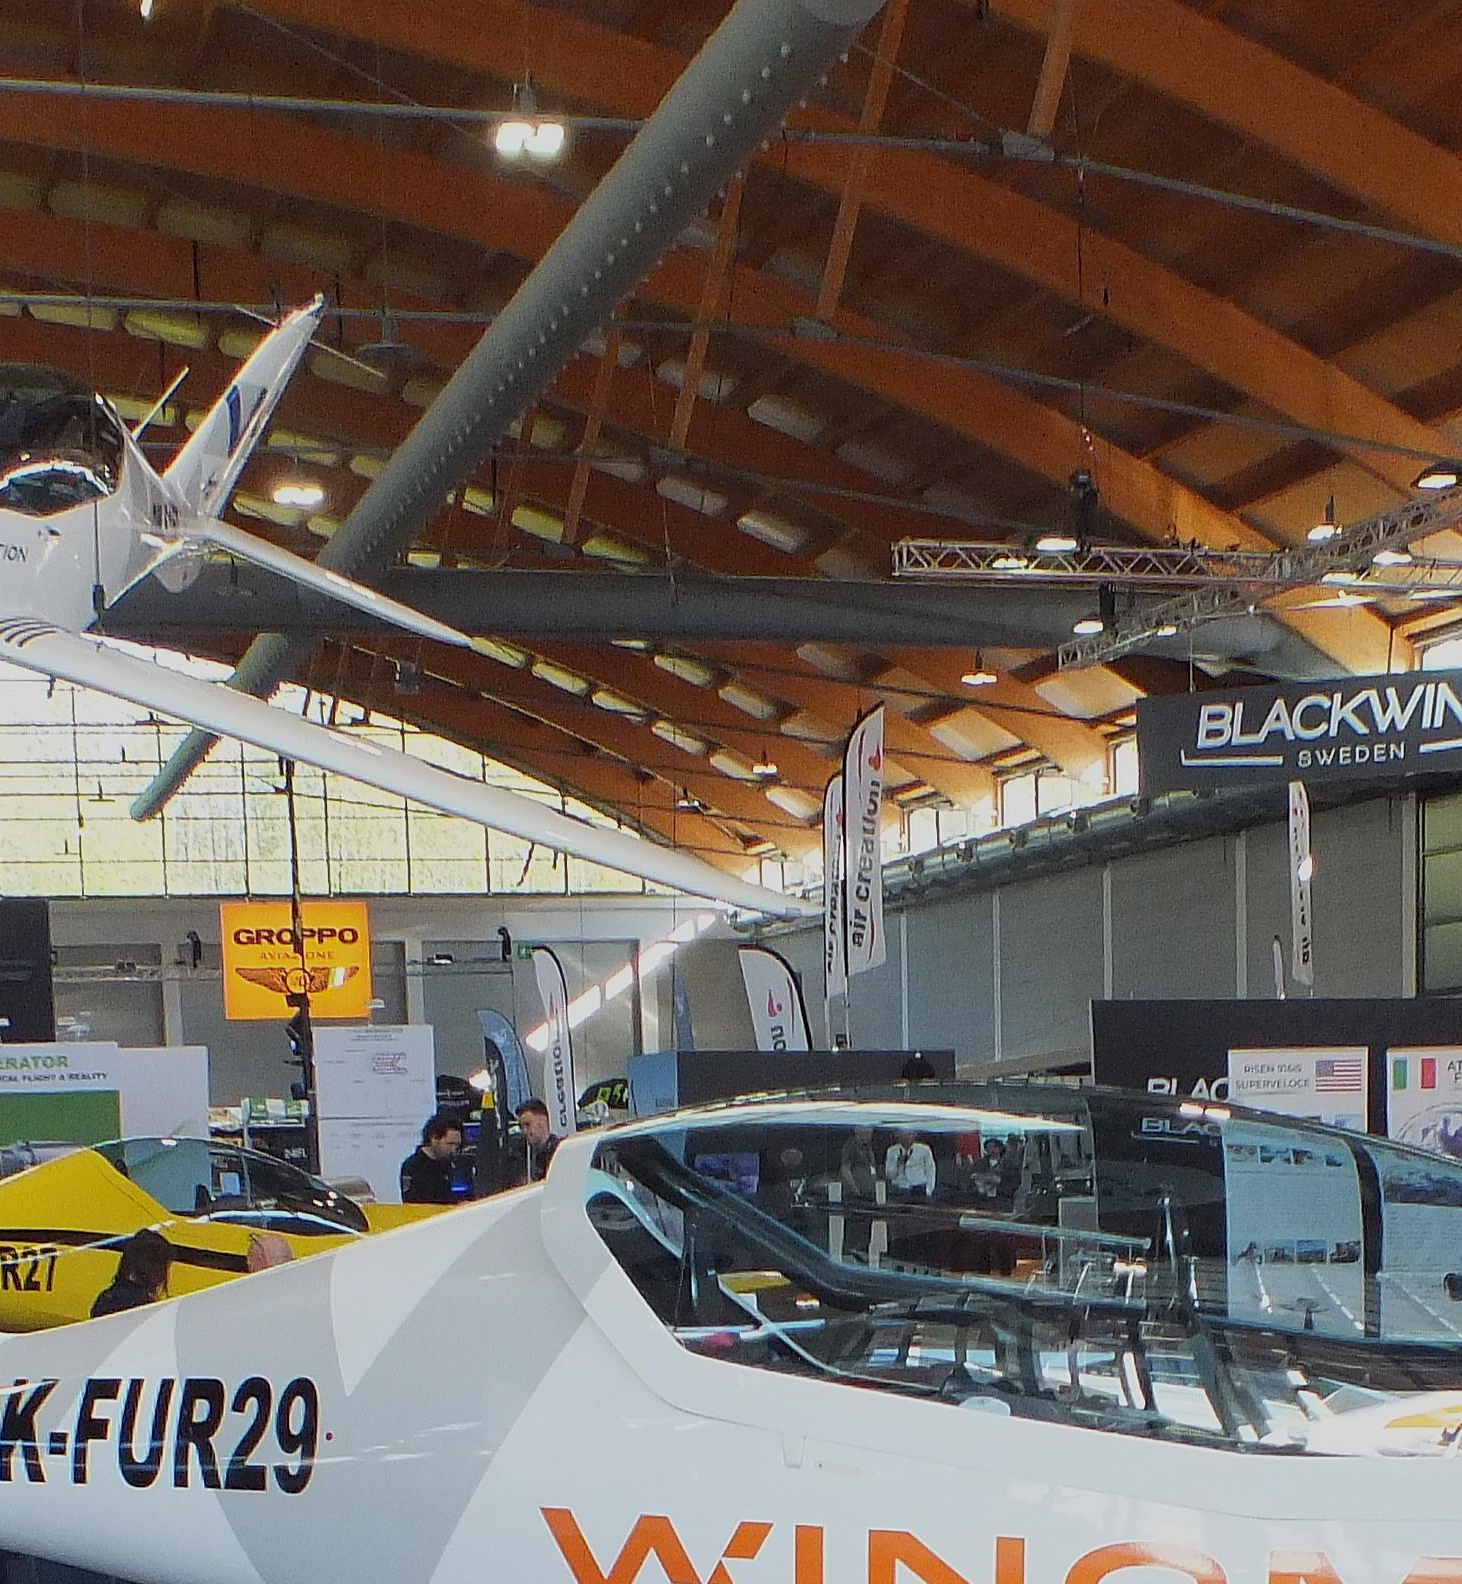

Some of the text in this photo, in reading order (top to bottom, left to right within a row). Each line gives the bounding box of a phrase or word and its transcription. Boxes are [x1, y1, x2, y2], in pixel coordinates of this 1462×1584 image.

[1297, 742, 1406, 768] SWEDEN
[233, 927, 359, 945] GROPPO
[1236, 1078, 1311, 1091] SUPERVELOCE
